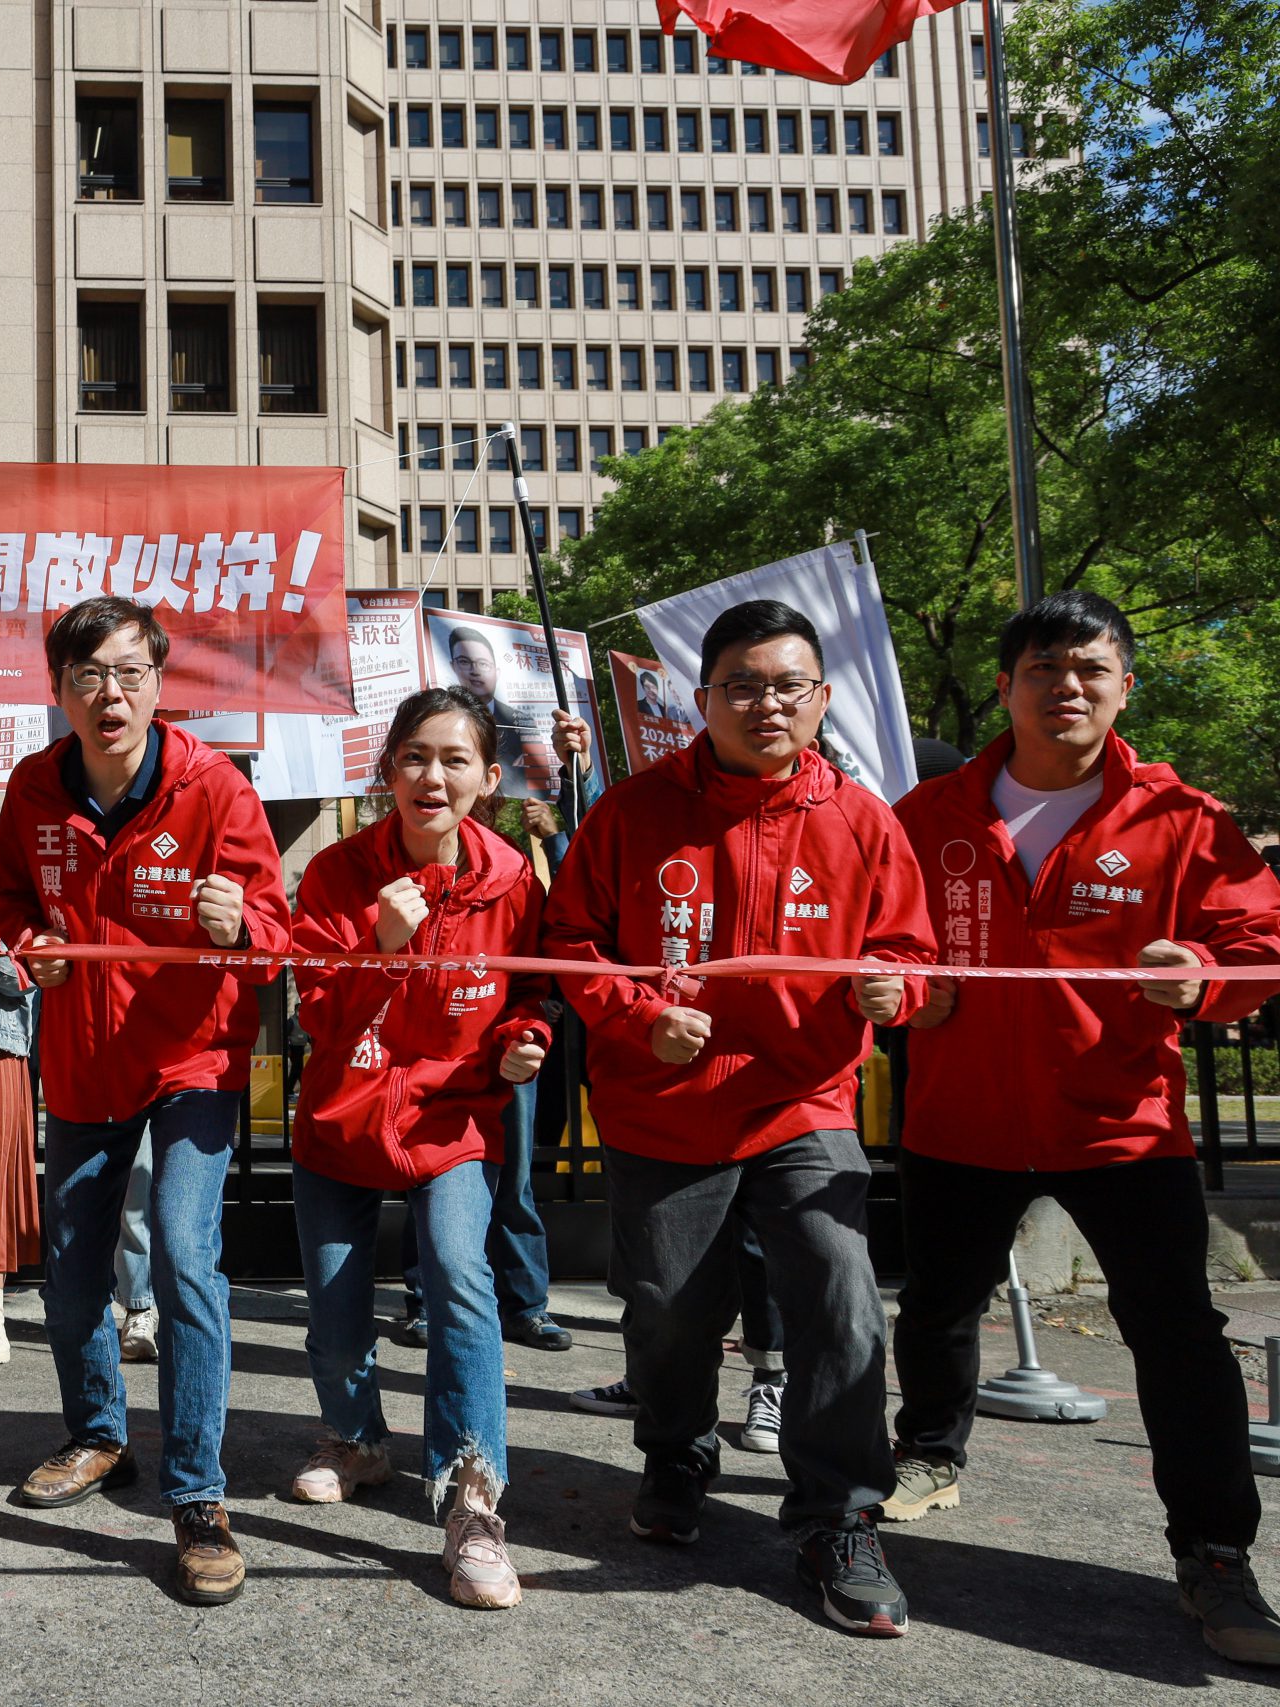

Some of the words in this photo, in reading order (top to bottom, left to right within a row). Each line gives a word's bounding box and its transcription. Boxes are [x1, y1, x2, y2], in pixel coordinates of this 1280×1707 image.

[28, 716, 42, 725] MAX
[27, 729, 41, 738] MAX
[27, 742, 41, 752] MAX
[133, 865, 192, 883] 台灣基進
[1071, 881, 1144, 904] 台灣基進
[140, 906, 184, 917] 中央黨部
[451, 982, 496, 1000] 台灣基進
